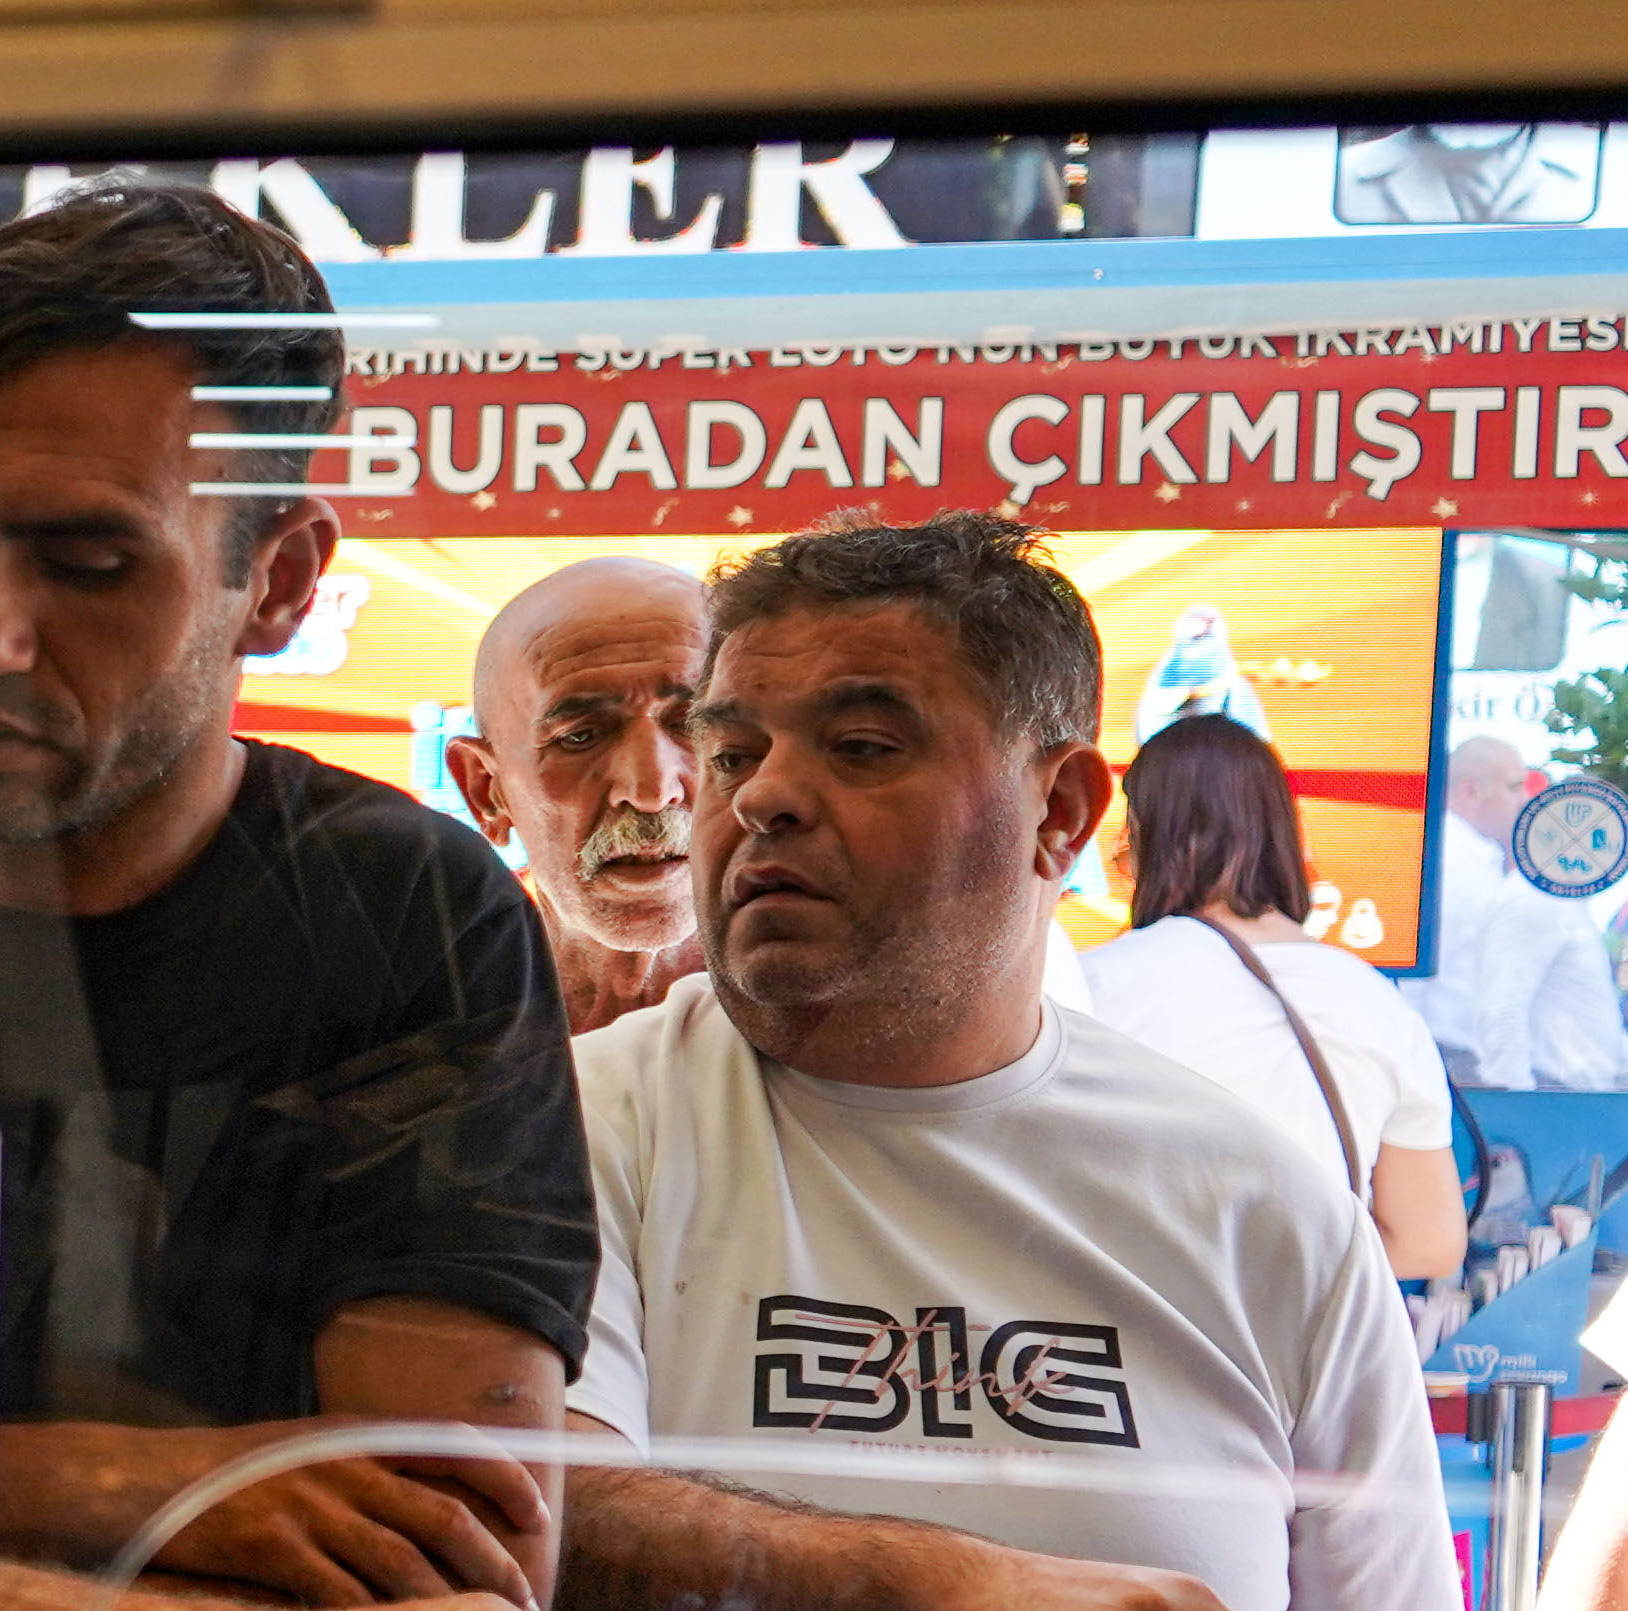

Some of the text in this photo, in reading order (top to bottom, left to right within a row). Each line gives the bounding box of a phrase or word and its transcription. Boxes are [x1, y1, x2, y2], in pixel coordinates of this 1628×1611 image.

[346, 396, 944, 495] BURADAN
[986, 386, 1628, 505] ÇIKMIŞTIR
[753, 1295, 1141, 1449] BIG
